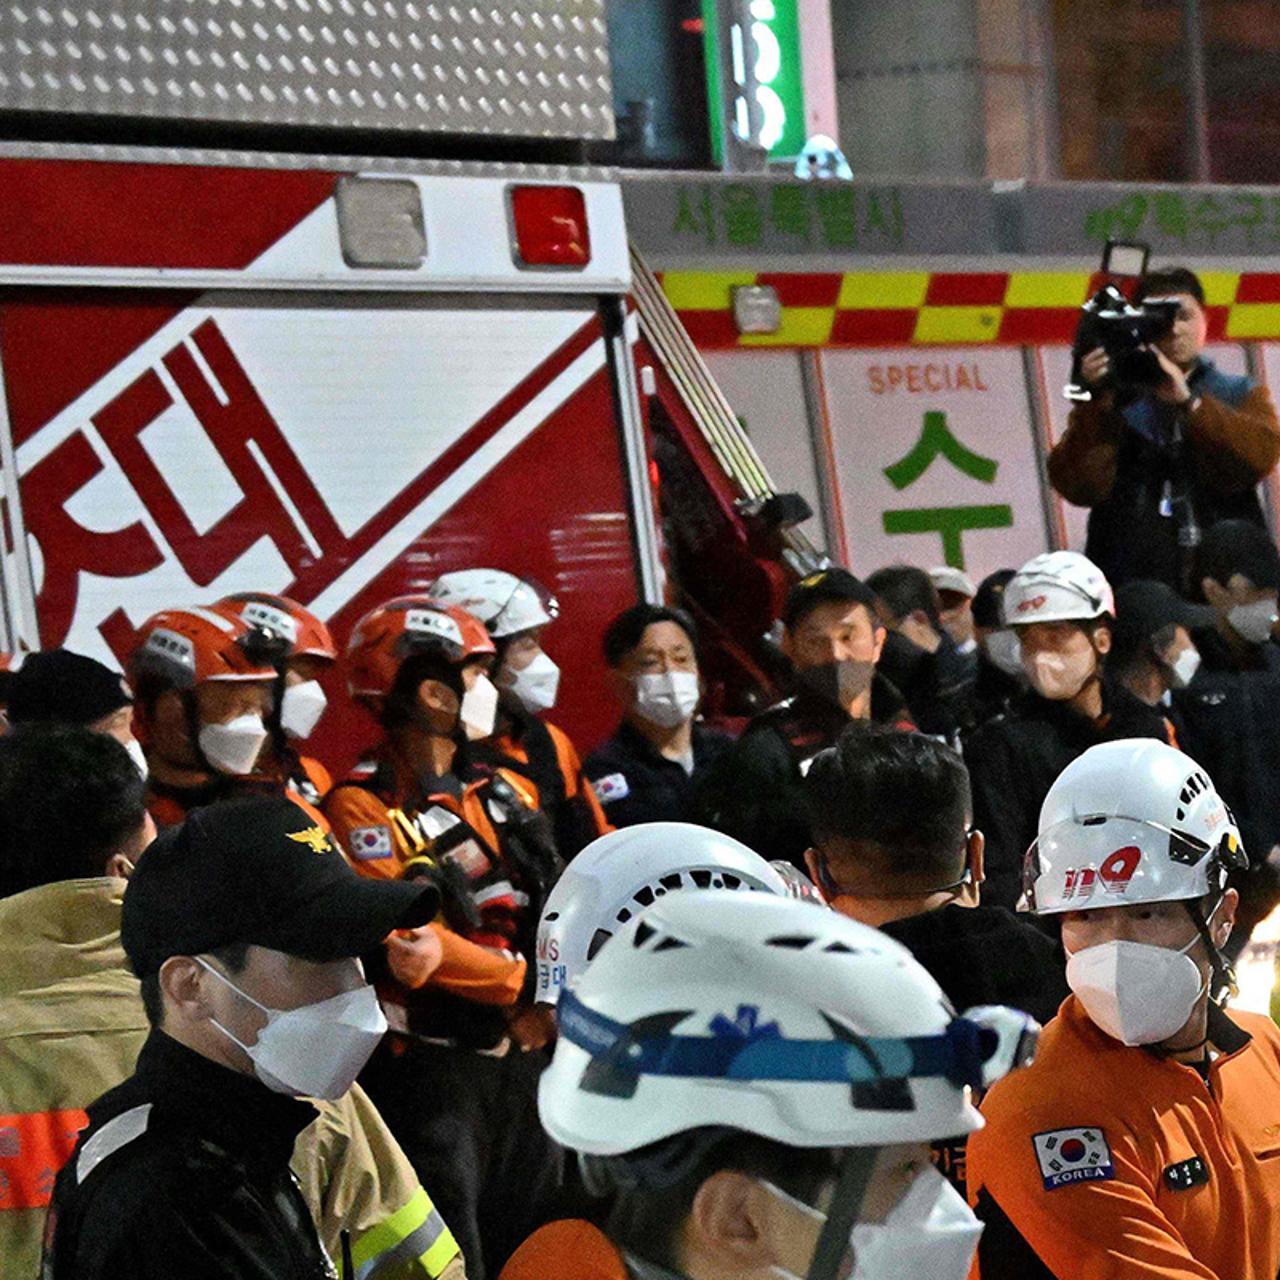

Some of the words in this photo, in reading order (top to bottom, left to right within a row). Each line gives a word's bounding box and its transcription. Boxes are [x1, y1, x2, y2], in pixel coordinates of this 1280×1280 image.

[673, 185, 903, 248] 서울특별시
[867, 361, 988, 393] SPECIAL
[1062, 846, 1142, 899] 119
[1053, 1168, 1105, 1185] KOREA
